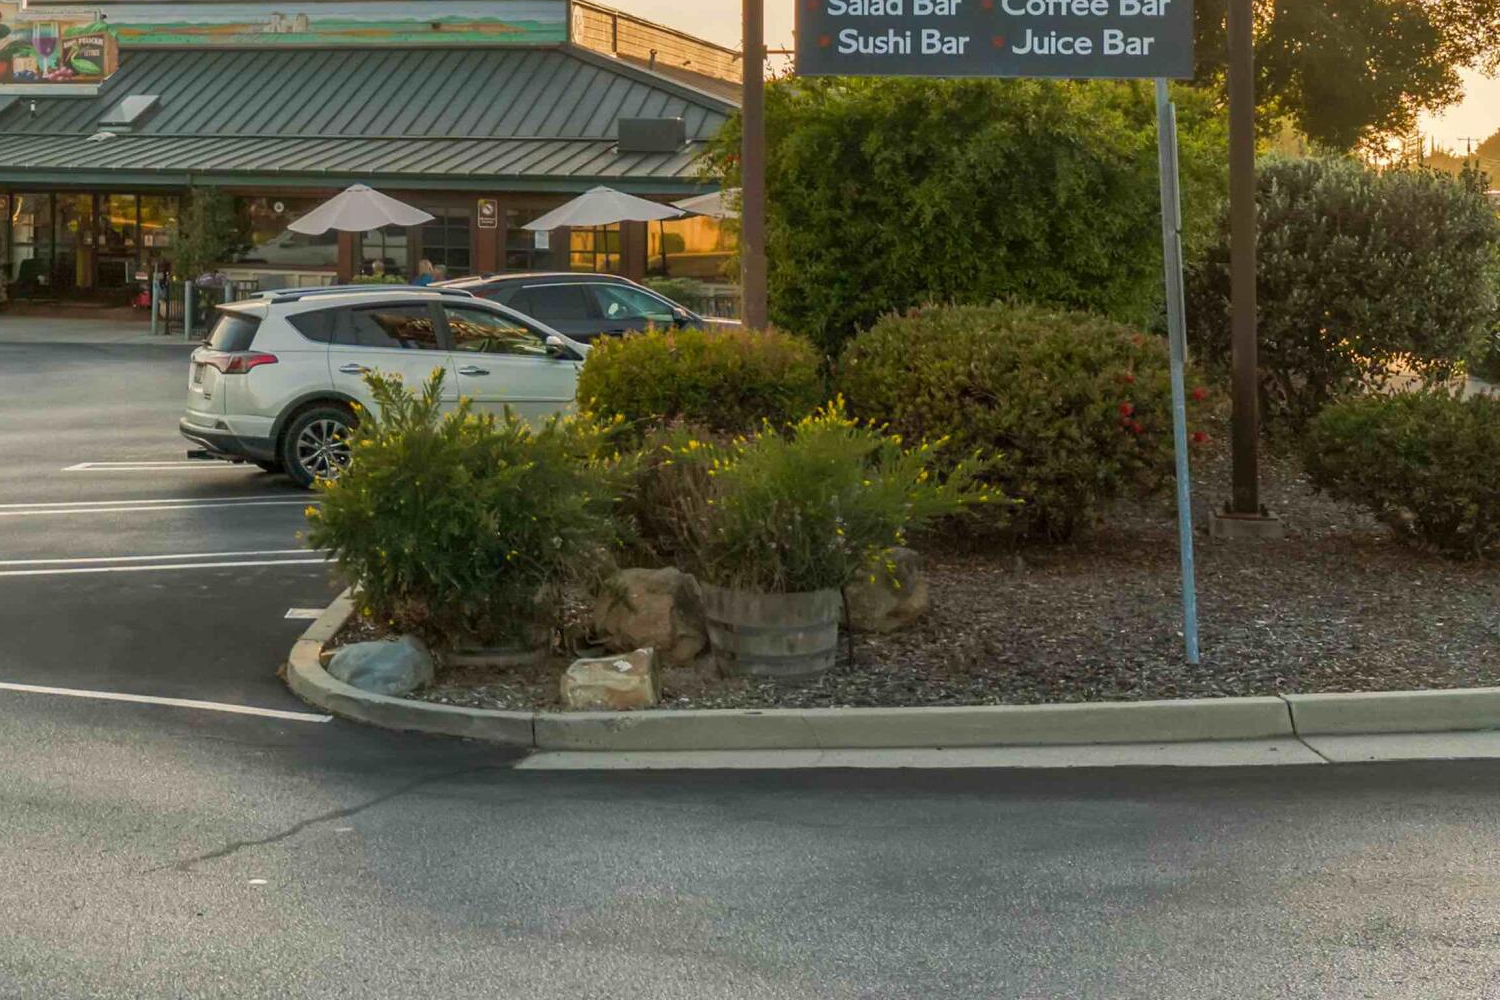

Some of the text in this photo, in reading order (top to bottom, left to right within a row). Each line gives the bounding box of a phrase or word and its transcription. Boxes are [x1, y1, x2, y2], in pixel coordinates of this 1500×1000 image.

[837, 28, 1156, 56] Sushi Bar Juice Bar
